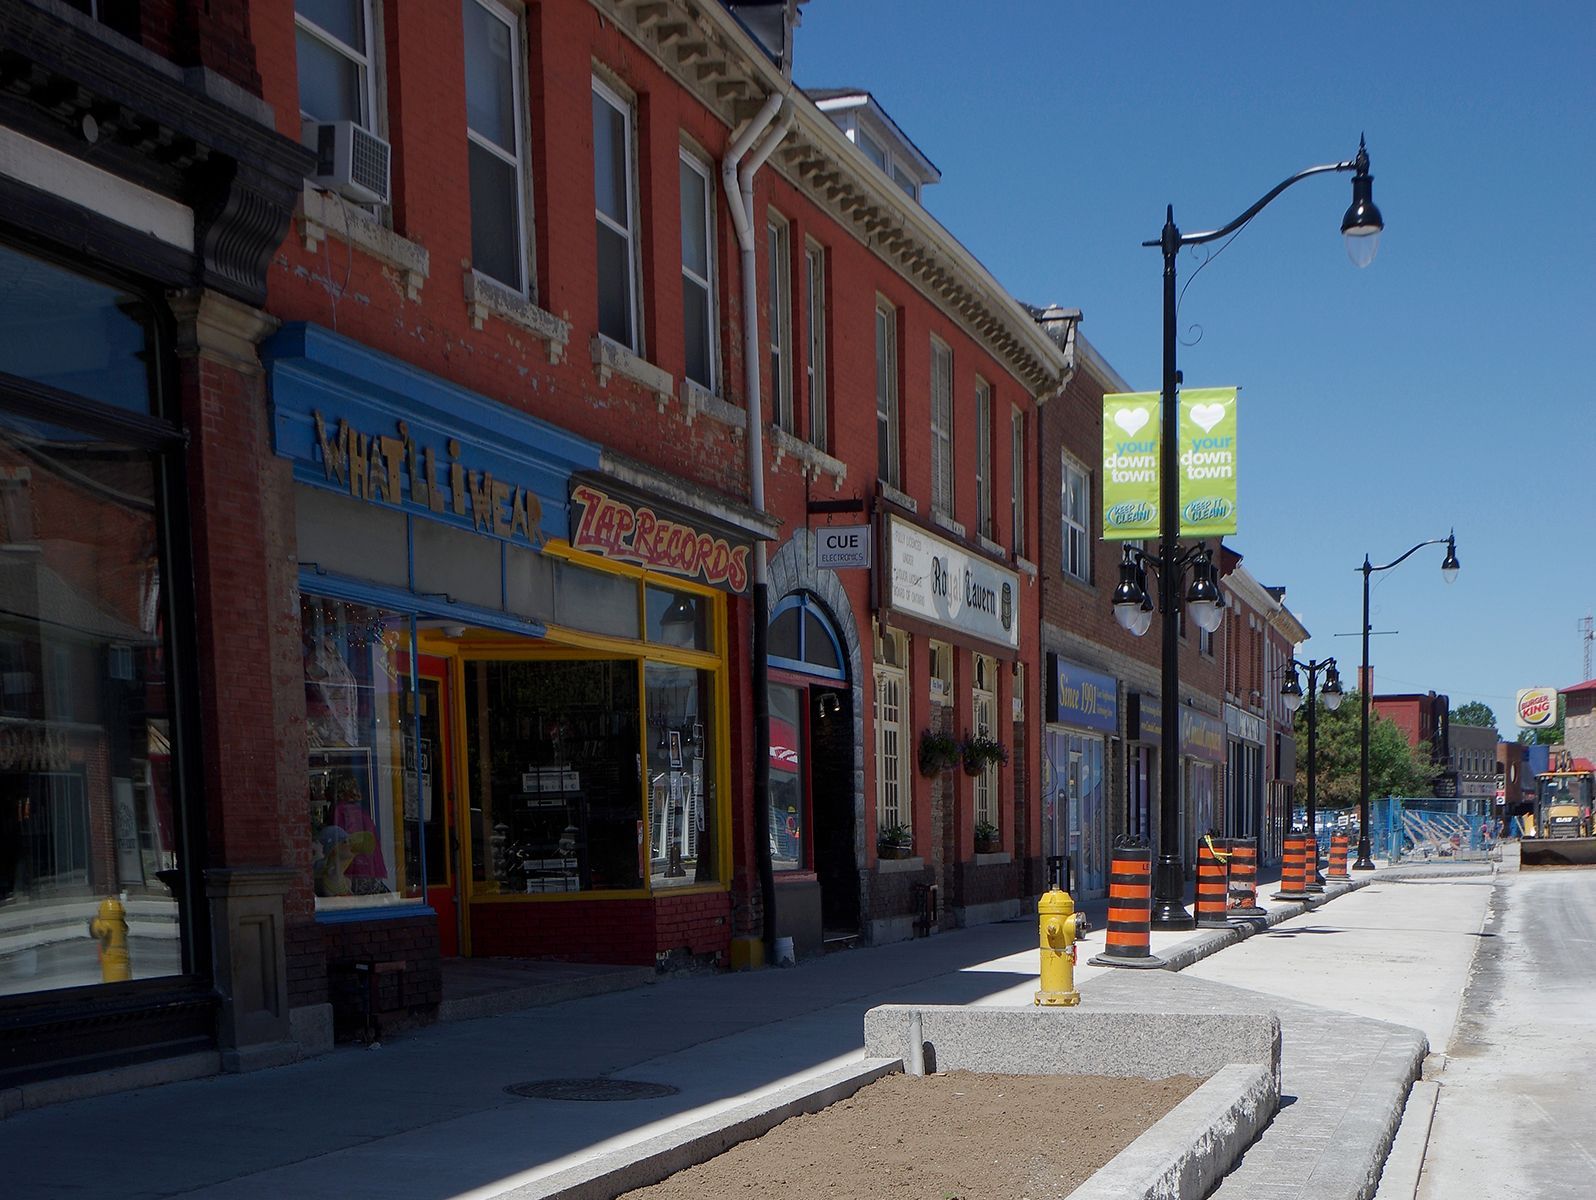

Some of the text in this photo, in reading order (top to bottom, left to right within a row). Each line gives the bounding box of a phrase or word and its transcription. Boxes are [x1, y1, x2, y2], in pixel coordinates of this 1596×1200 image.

[1116, 440, 1155, 457] your
[1192, 437, 1231, 453] your
[1105, 453, 1155, 469] down
[1180, 449, 1231, 466] down
[313, 408, 445, 514] WHAT'LL
[468, 469, 545, 546] WEAR
[1111, 468, 1155, 483] town
[1187, 465, 1232, 480] town
[1113, 503, 1136, 516] KEEP
[1190, 499, 1212, 513] KEEP
[572, 485, 750, 594] ZAP RECORDS
[826, 534, 859, 549] CUE
[821, 553, 864, 562] ELECTRONICS
[932, 556, 996, 615] Royal Tavern
[1059, 673, 1080, 709] Since
[1080, 682, 1097, 714] 1991
[1521, 695, 1550, 710] BURGER
[1521, 701, 1550, 720] KING
